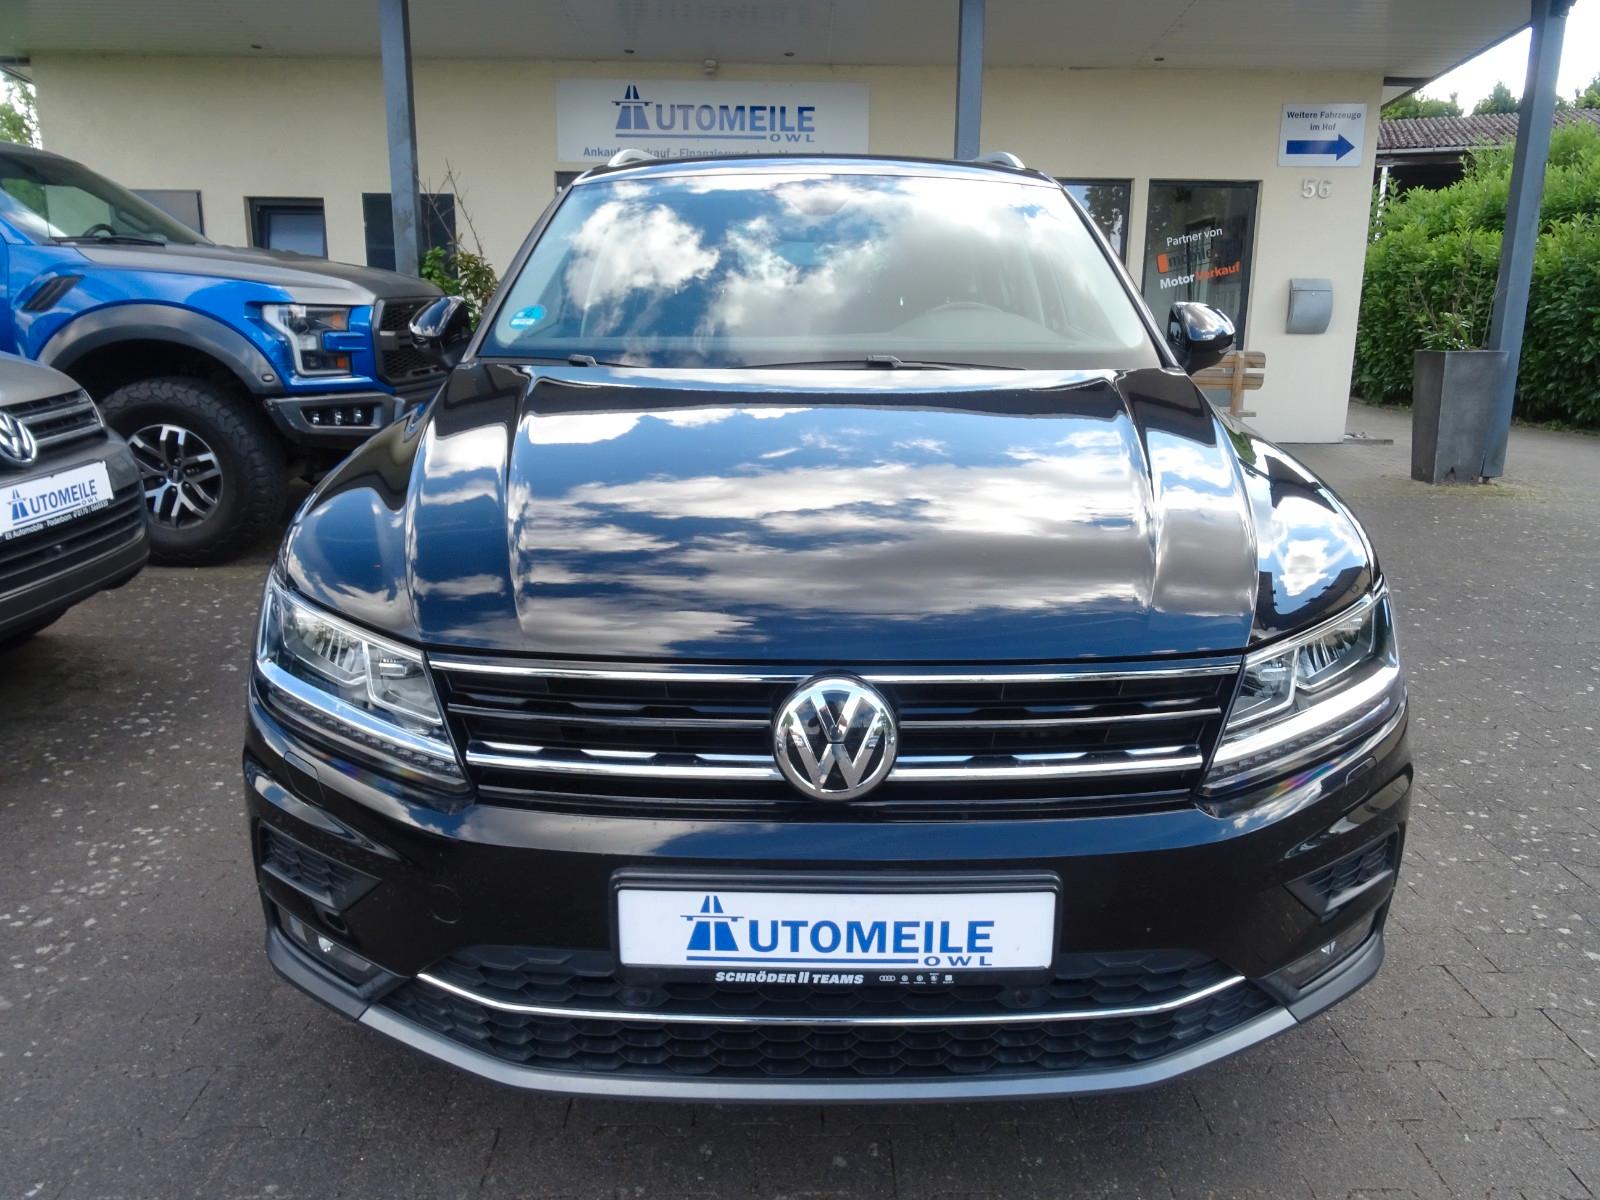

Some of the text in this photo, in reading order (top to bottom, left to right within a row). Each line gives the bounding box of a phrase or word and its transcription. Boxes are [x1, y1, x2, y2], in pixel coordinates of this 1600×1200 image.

[1287, 111, 1362, 120] Weitere Fahrzeuge
[1310, 123, 1336, 131] im Hof
[770, 134, 815, 142] OWL
[1301, 179, 1332, 199] 56
[1166, 228, 1223, 247] Partner von
[923, 956, 993, 966] OWL
[715, 971, 797, 983] SCHRÖDER
[812, 974, 864, 984] TEAMS
